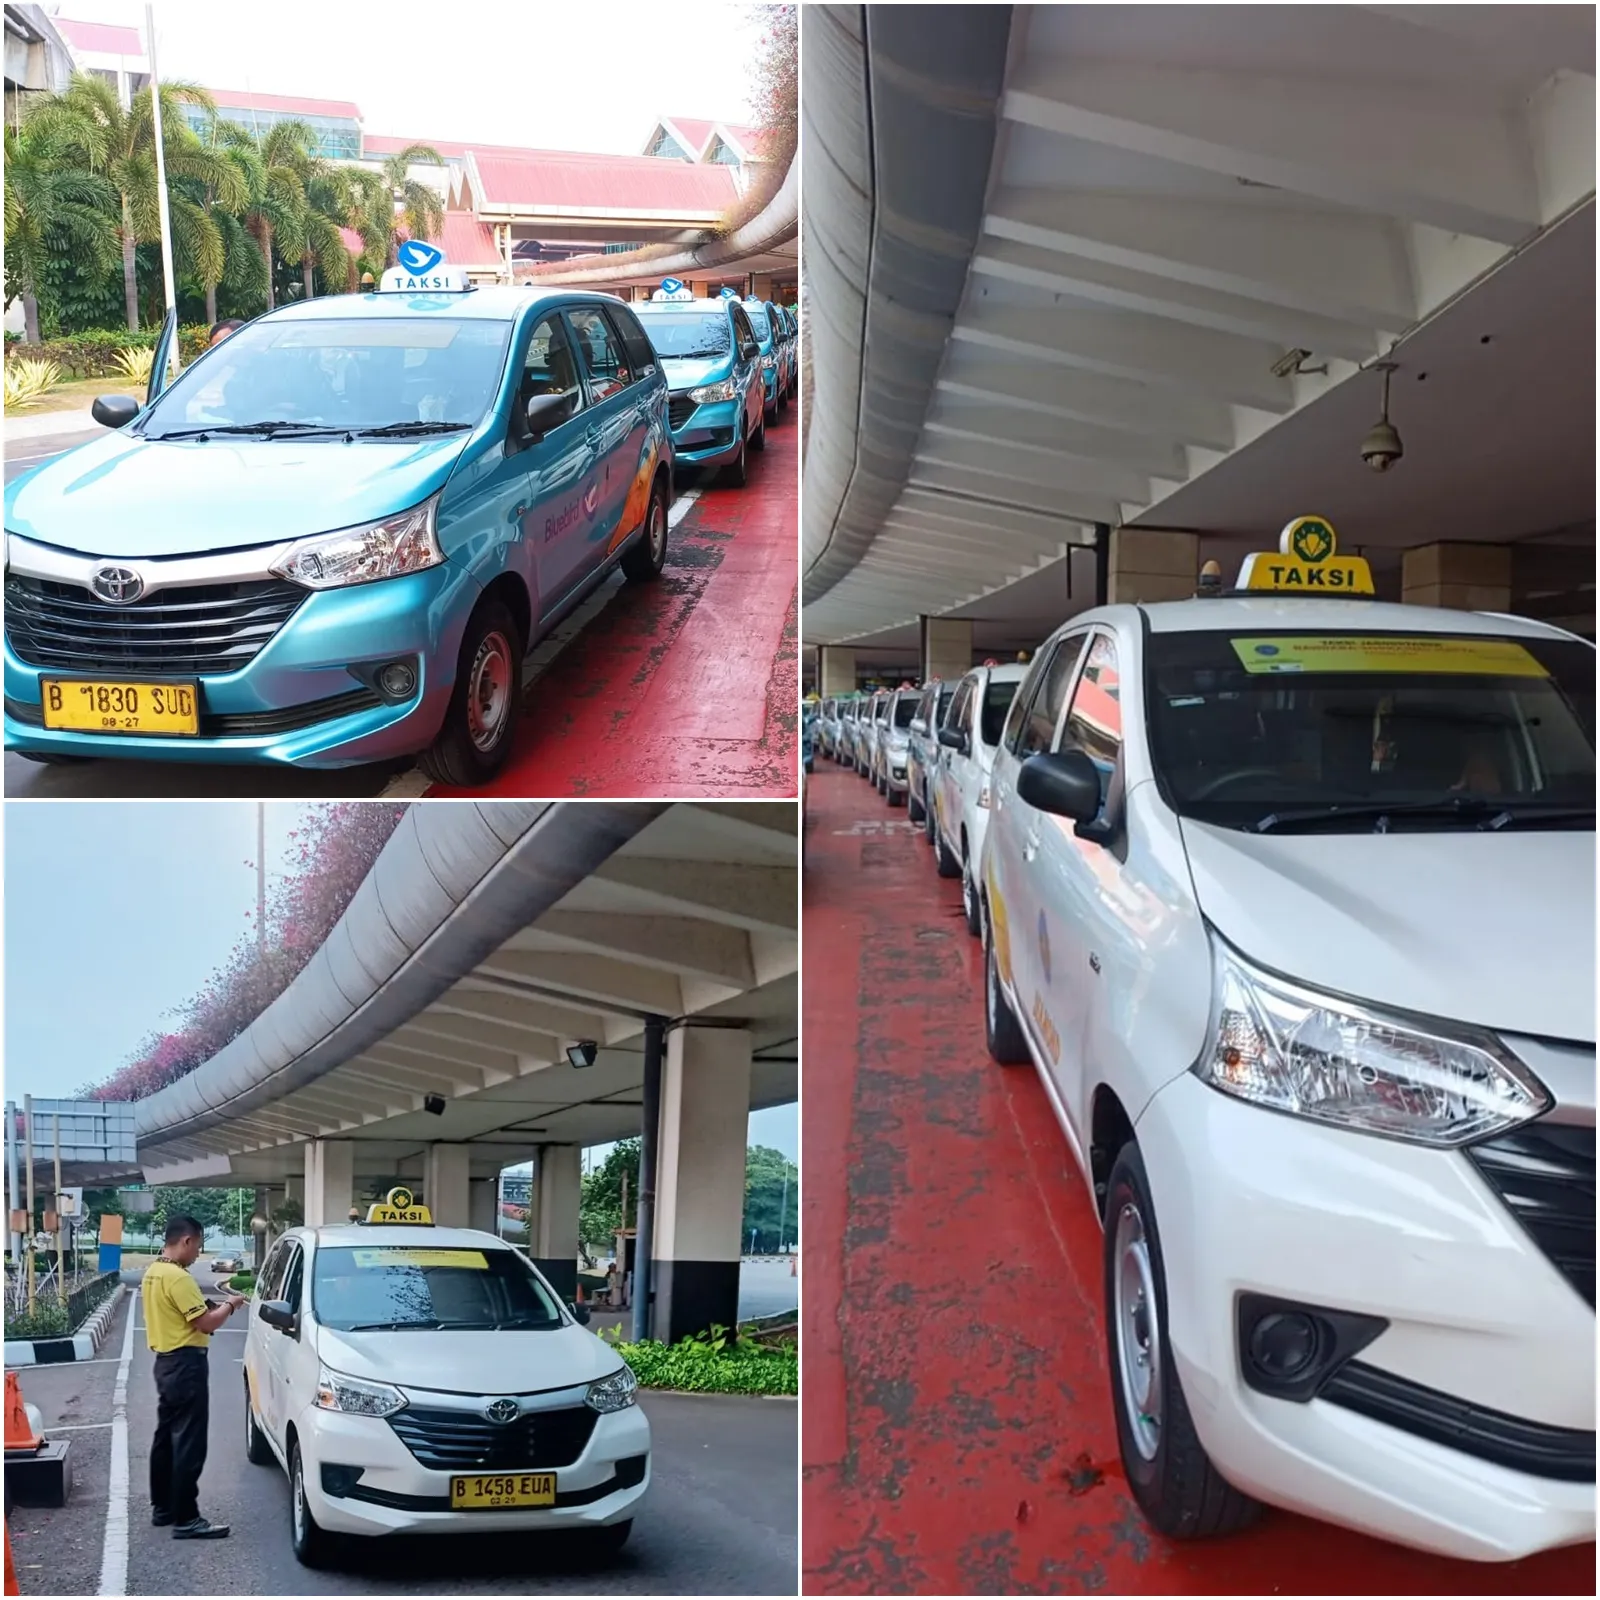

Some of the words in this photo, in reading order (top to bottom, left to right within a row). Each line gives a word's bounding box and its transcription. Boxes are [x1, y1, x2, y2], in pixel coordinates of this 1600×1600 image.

[394, 277, 449, 288] TAKSI
[544, 497, 579, 543] Bluebird
[1269, 566, 1354, 587] TAKSI
[49, 684, 63, 711] B
[86, 685, 138, 713] 1830
[380, 1210, 422, 1221] TAKSI
[456, 1479, 466, 1497] B
[474, 1478, 514, 1497] 1458
[520, 1477, 551, 1495] EUA
